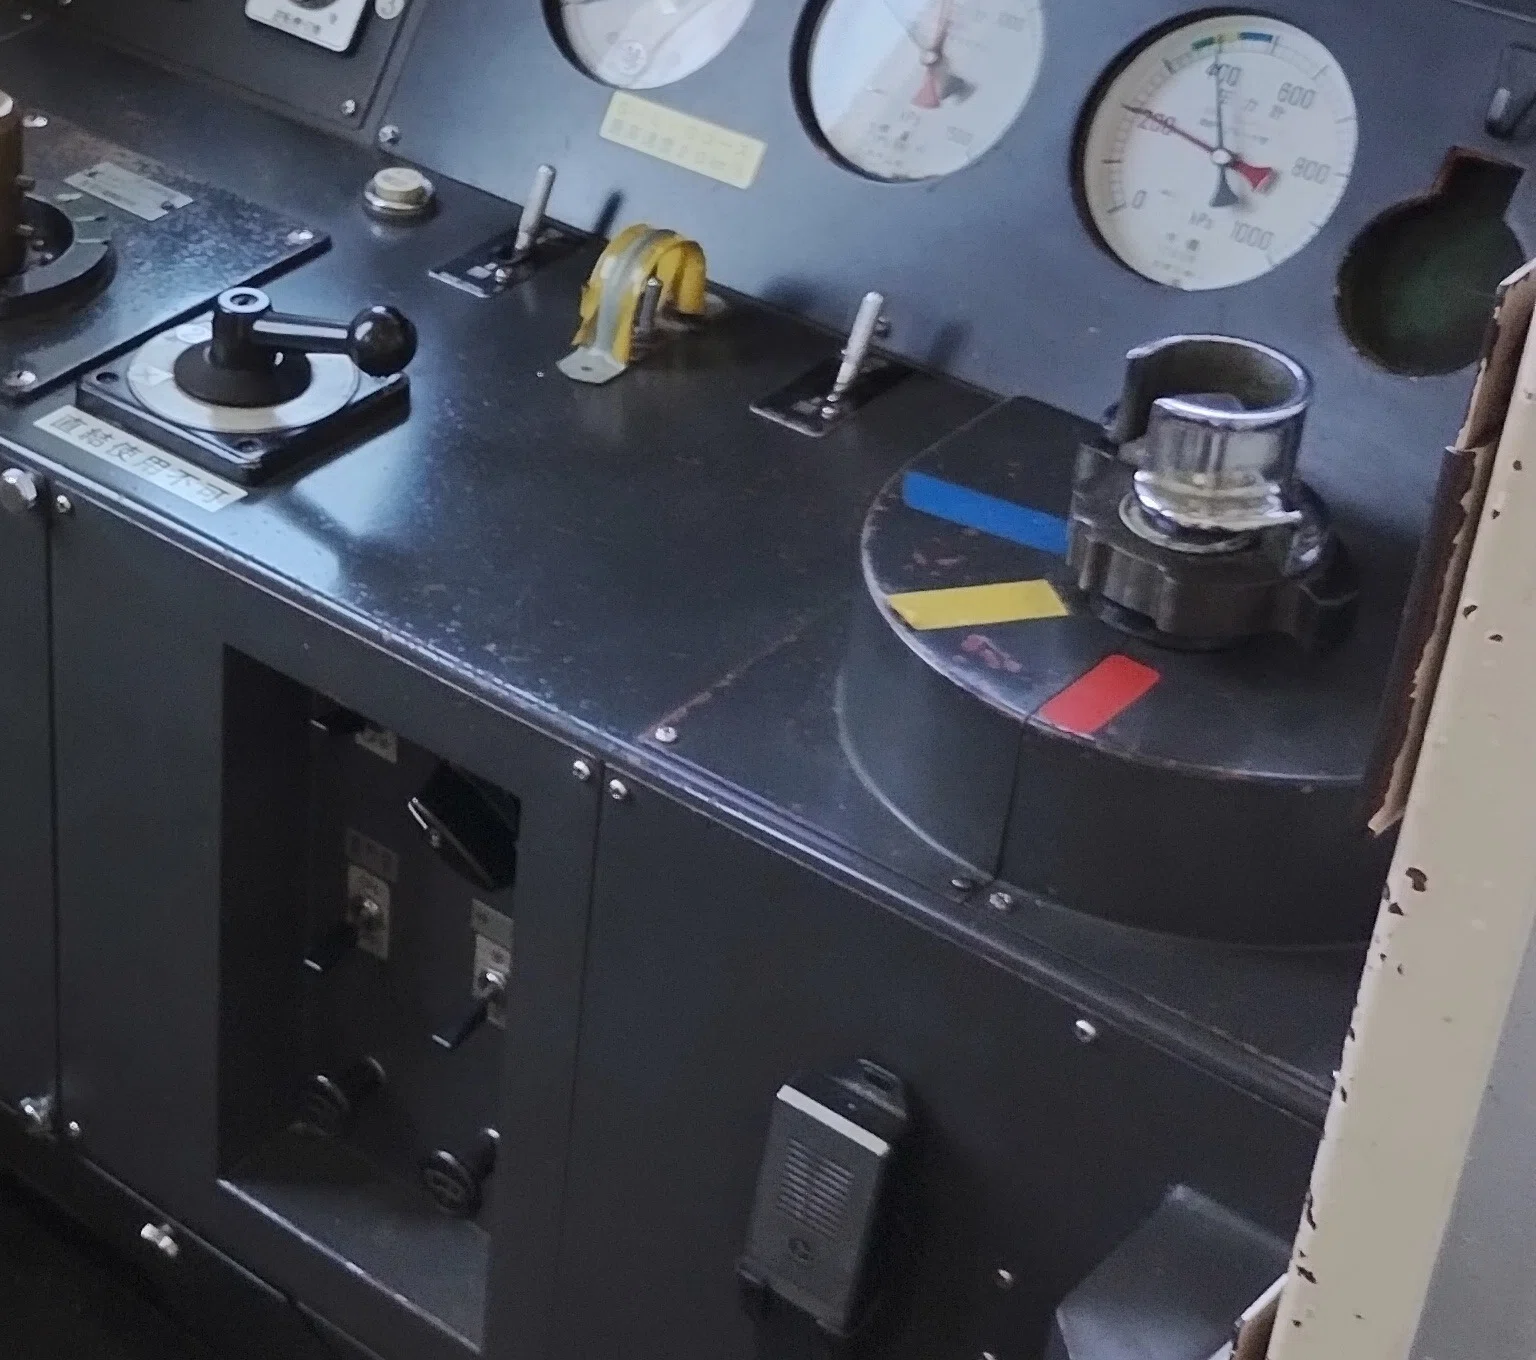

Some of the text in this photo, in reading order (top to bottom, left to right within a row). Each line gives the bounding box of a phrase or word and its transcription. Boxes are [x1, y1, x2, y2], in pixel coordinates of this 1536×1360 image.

[1205, 62, 1243, 88] 400
[1277, 81, 1317, 110] 600
[1137, 111, 1177, 136] 200
[1291, 155, 1332, 186] 800
[1131, 189, 1148, 211] 0
[1231, 219, 1275, 251] 1000
[49, 413, 232, 505] 直結使用不可
